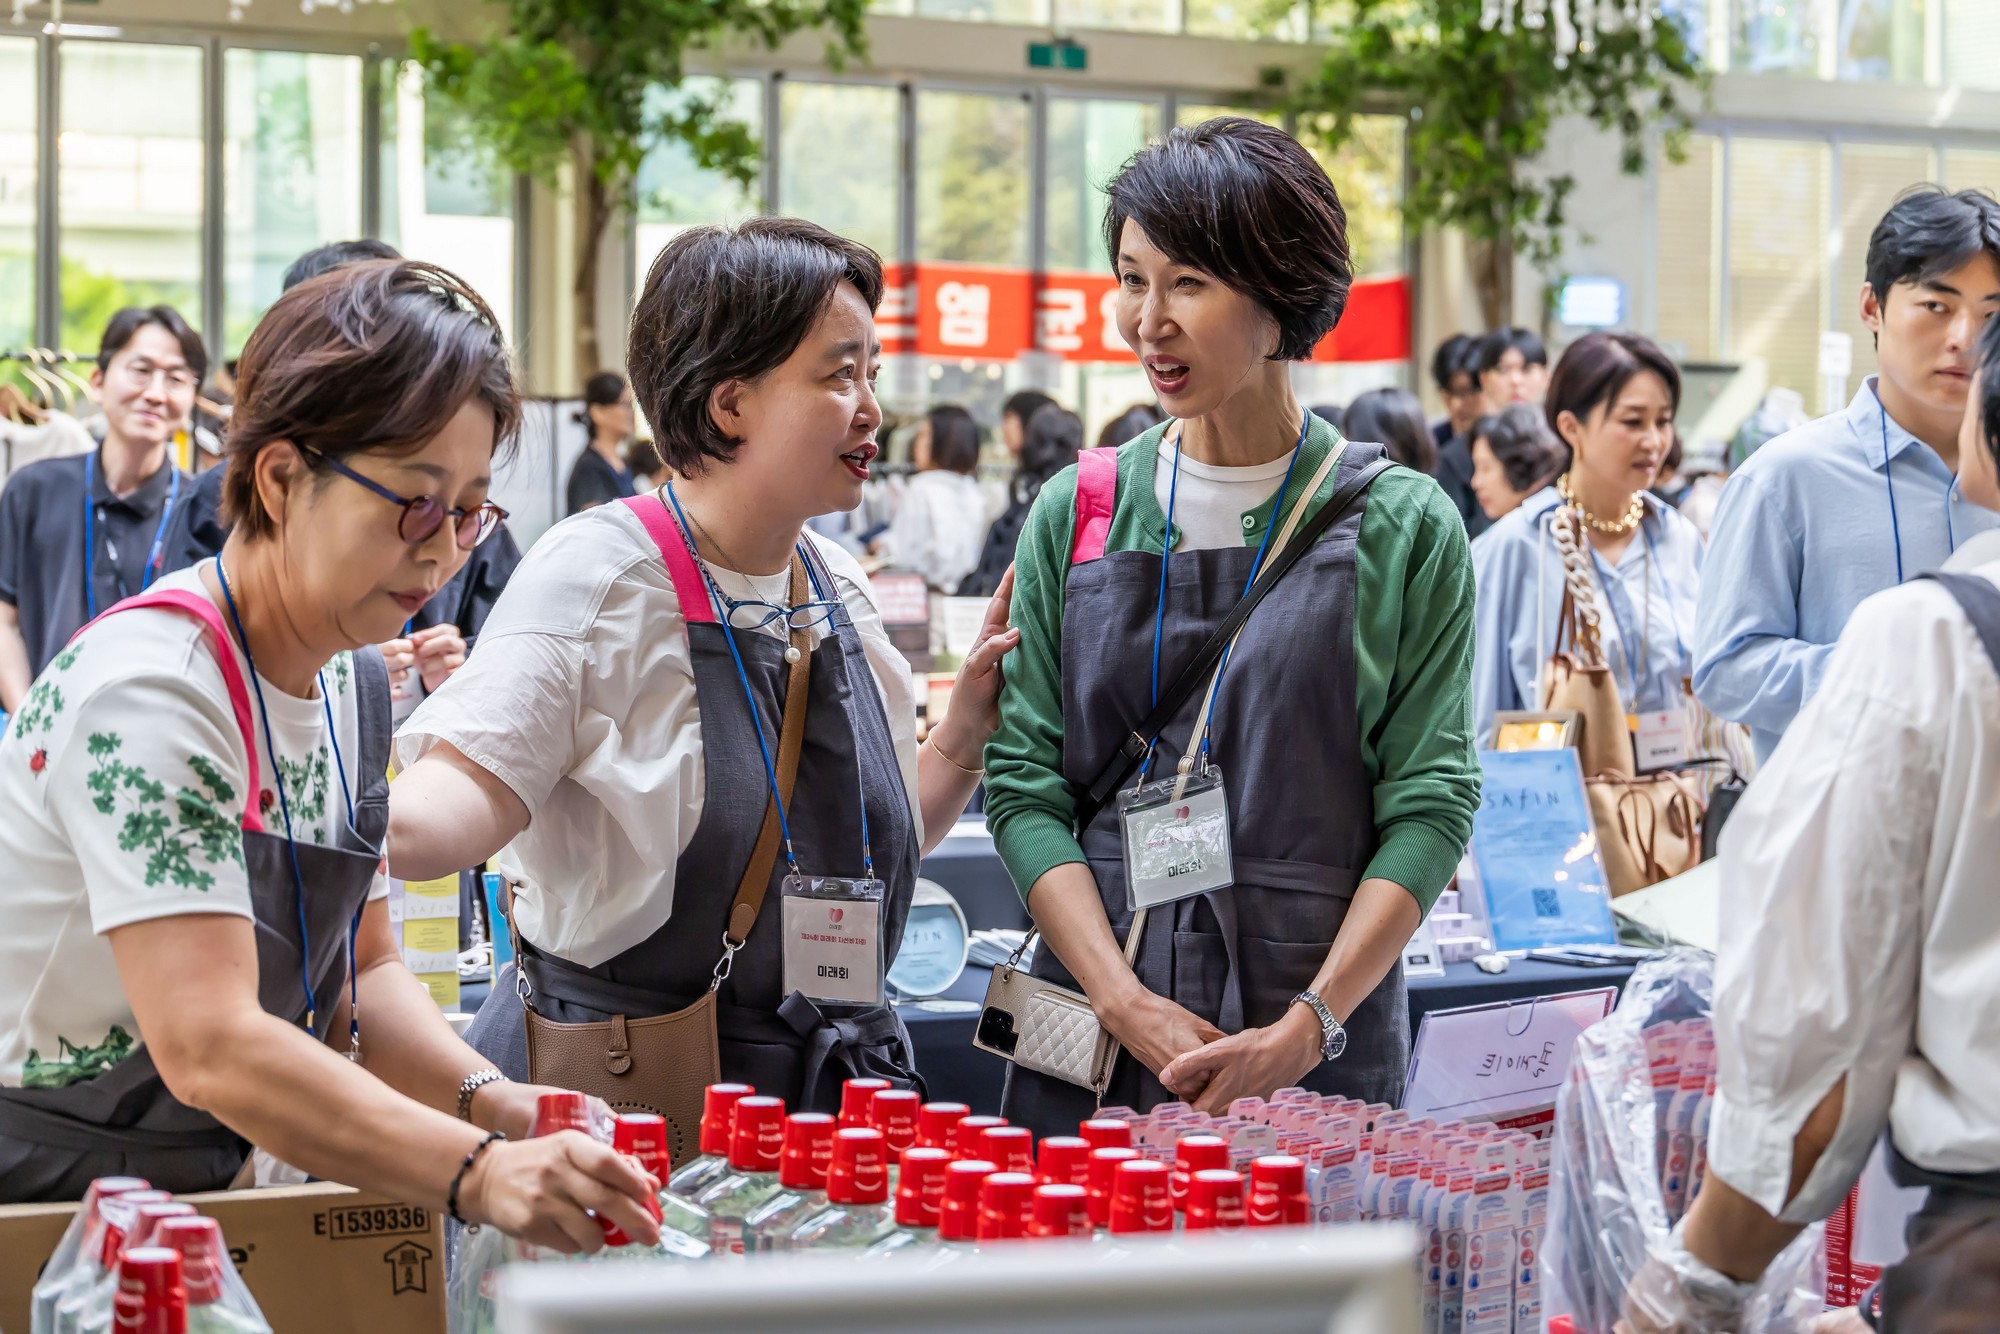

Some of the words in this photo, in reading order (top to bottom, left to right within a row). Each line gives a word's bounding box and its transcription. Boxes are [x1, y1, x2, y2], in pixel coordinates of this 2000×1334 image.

[817, 965, 849, 979] 미래회
[313, 1213, 327, 1235] E
[334, 1206, 425, 1233] 1539336
